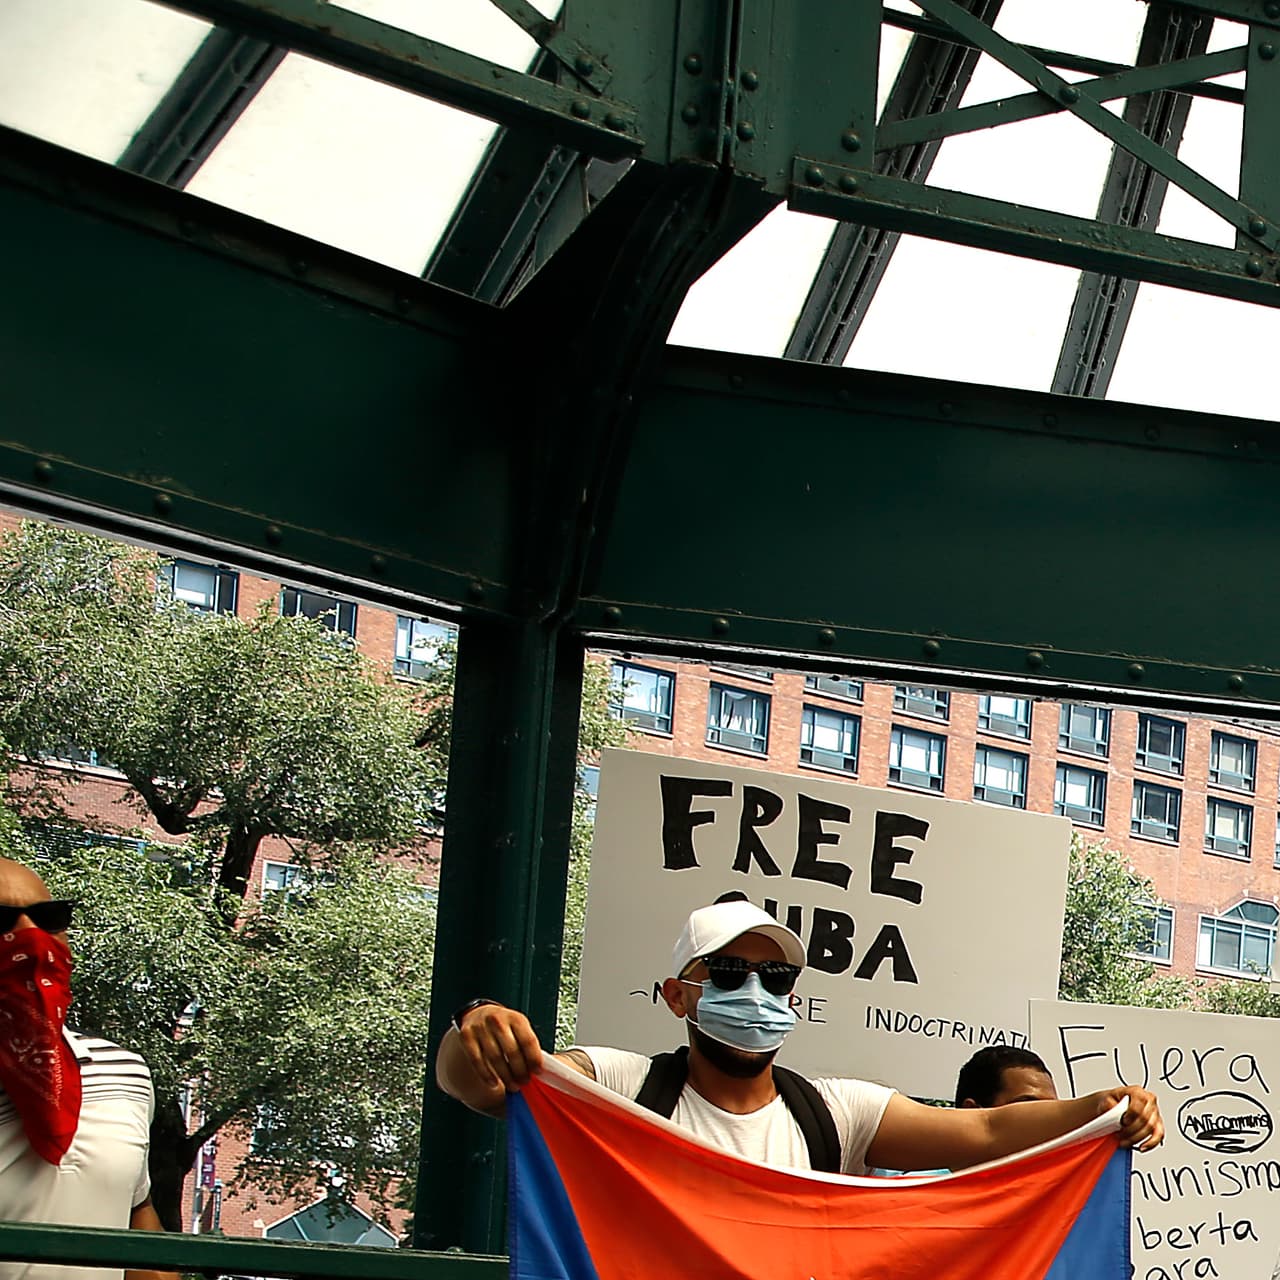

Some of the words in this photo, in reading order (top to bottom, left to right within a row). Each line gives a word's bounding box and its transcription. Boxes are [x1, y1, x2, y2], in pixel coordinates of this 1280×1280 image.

[660, 774, 930, 905] FREE
[1058, 1025, 1270, 1098] Fuera
[1137, 1211, 1259, 1250] berta
